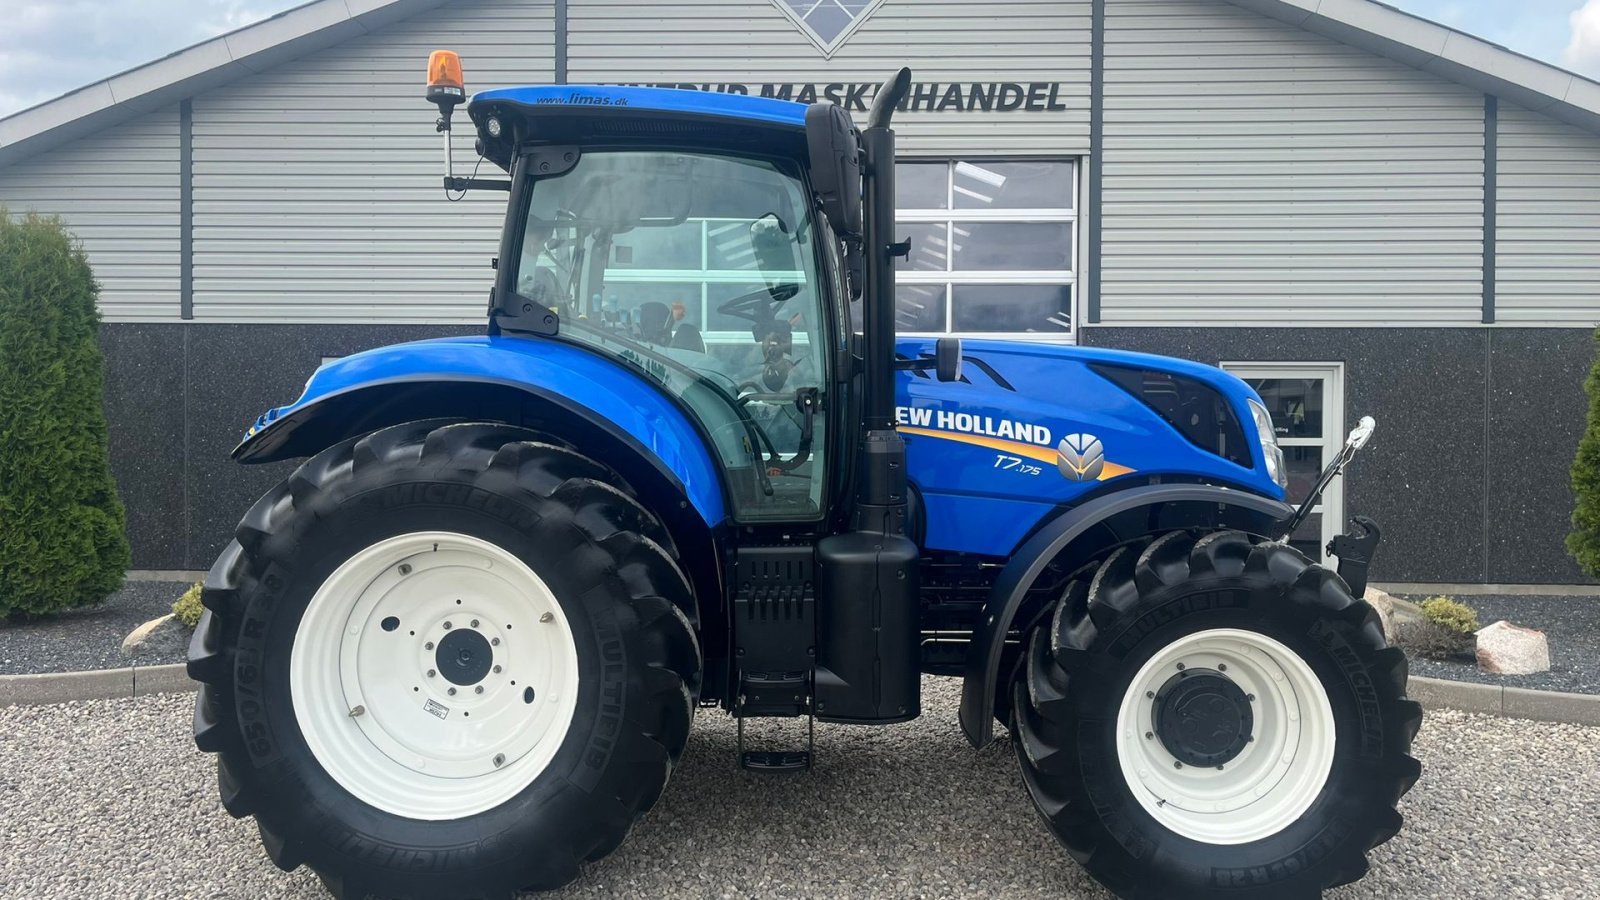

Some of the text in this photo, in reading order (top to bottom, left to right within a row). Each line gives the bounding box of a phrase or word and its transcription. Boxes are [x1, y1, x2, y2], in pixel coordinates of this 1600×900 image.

[536, 93, 629, 106] www.limas.dk
[895, 406, 1051, 445] EW HOLLAND
[993, 454, 1042, 476] T7.175
